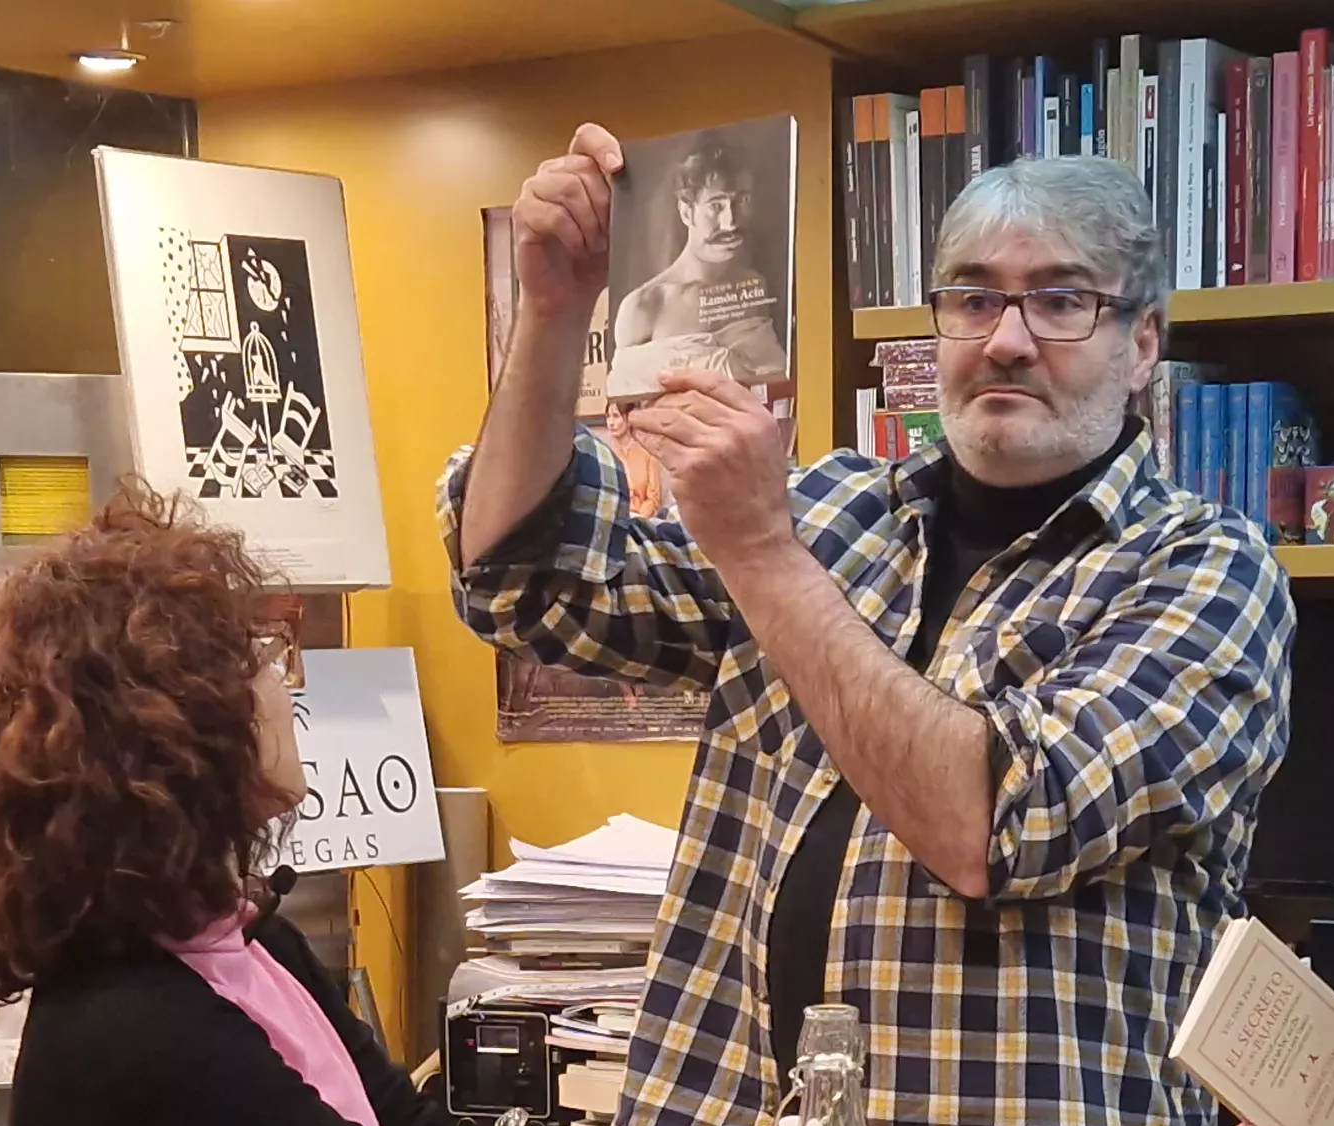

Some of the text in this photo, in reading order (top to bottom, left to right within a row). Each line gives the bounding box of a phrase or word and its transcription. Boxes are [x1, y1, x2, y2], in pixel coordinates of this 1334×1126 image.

[699, 288, 765, 307] Ramón Acín
[1225, 970, 1284, 1069] EL SECRETO
[1253, 982, 1295, 1050] PAJARITAS
